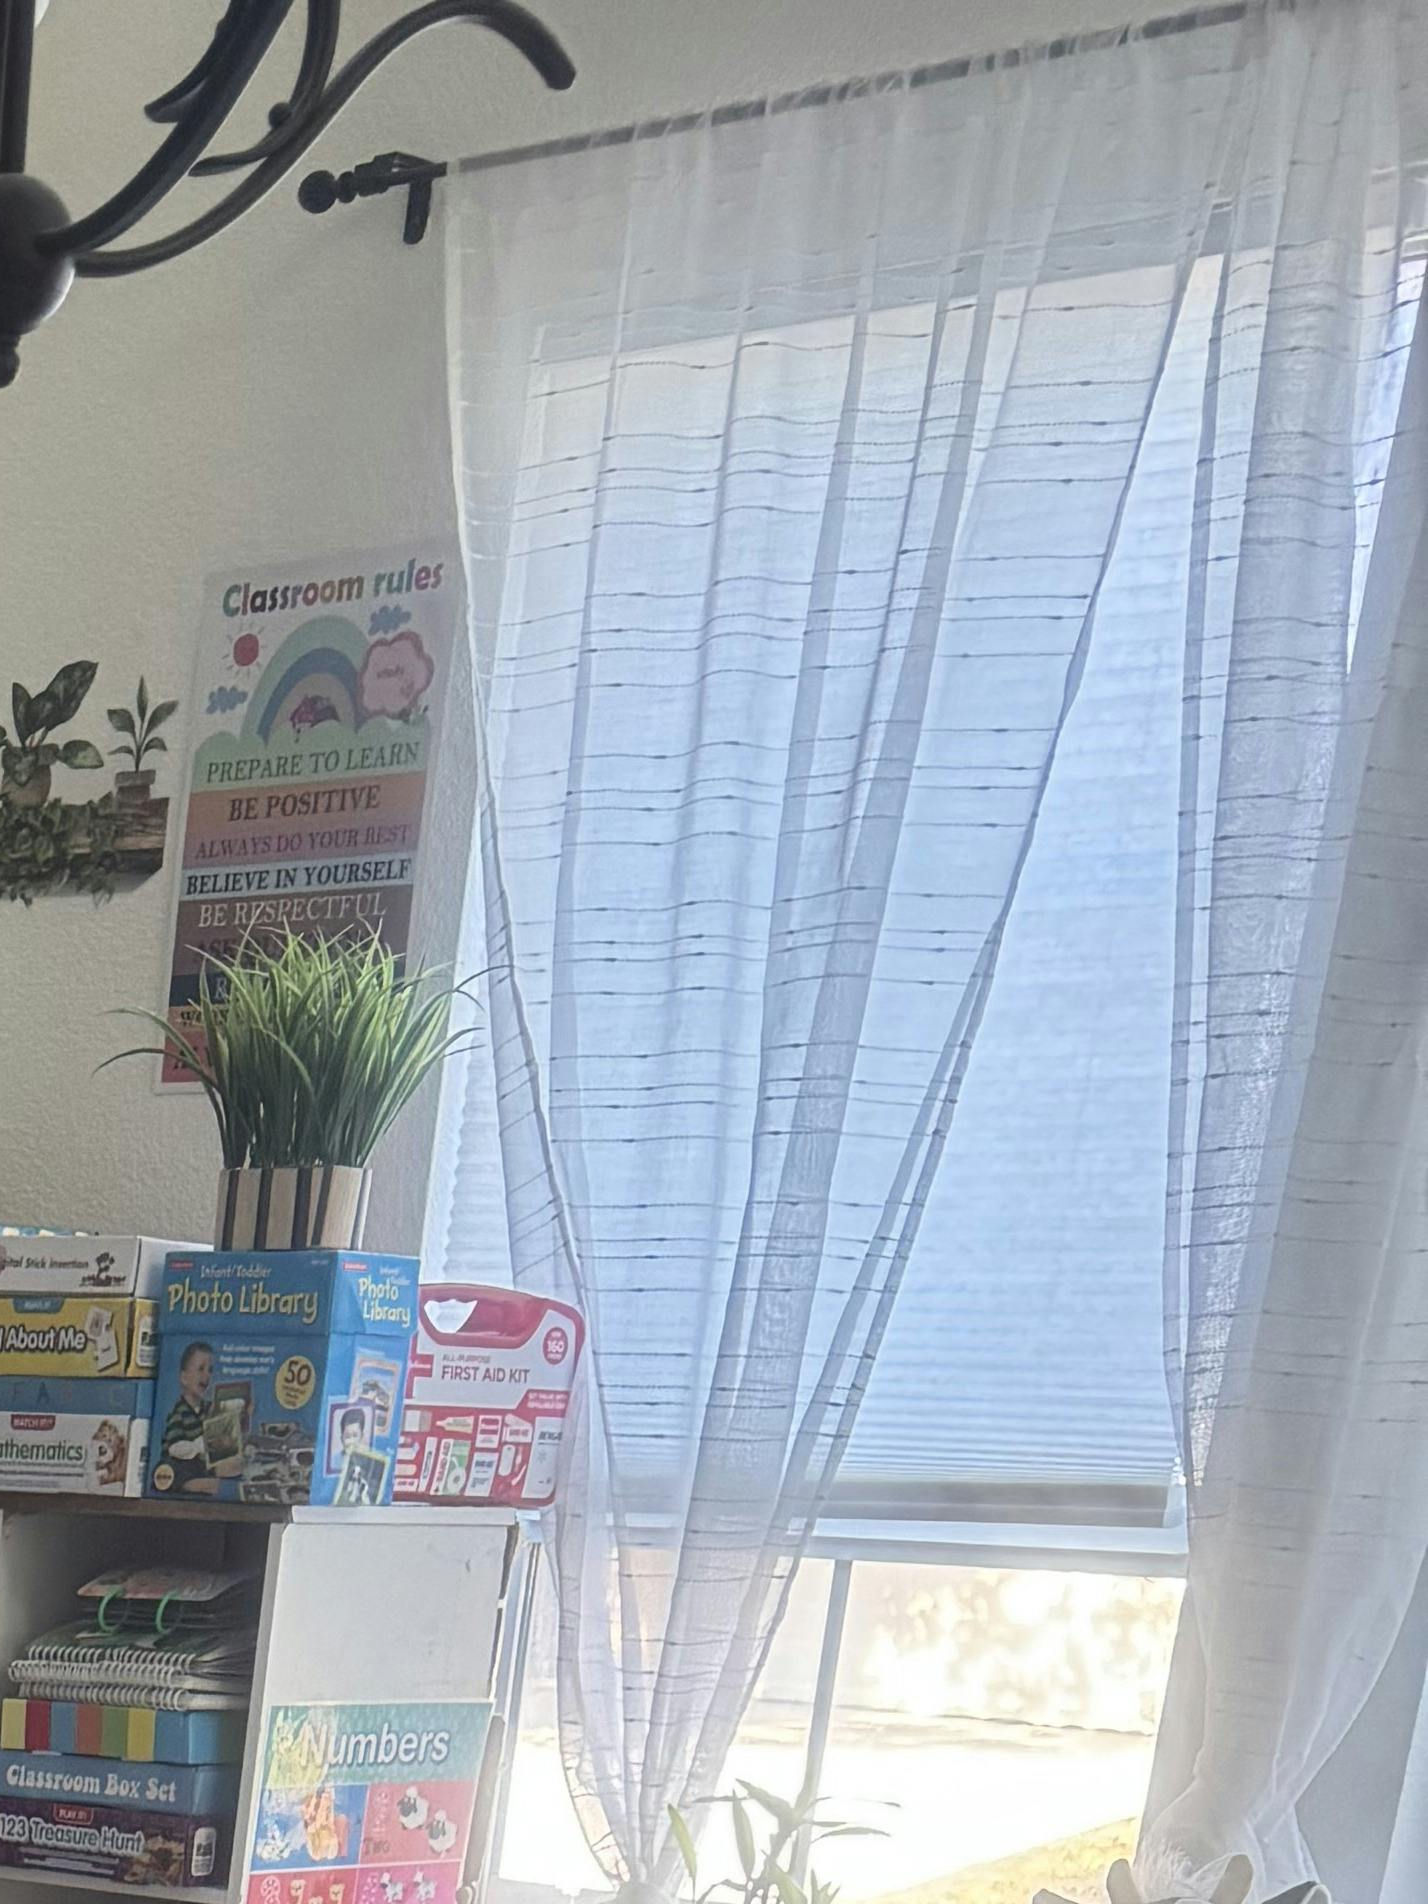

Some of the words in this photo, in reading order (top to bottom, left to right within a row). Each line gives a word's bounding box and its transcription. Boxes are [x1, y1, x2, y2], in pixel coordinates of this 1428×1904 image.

[222, 574, 364, 618] Classroom
[373, 558, 443, 596] rules
[207, 757, 302, 782] PREPARE
[308, 752, 340, 772] TO
[344, 742, 419, 769] LEARN
[228, 798, 259, 820] BE
[264, 785, 381, 817] POSITIVE
[186, 868, 267, 895] BELIEVE
[271, 865, 296, 887] IN
[302, 859, 411, 885] YOURSELF
[167, 1284, 232, 1314] Photo
[239, 1288, 318, 1324] Library
[5, 1328, 57, 1349] About
[59, 1327, 86, 1349] Me
[546, 1338, 565, 1353] 160
[283, 1362, 311, 1386] 50
[441, 1365, 477, 1383] FIRST
[481, 1366, 506, 1383] AID
[510, 1368, 530, 1383] KIT
[299, 1720, 449, 1764] Numbers
[7, 1765, 100, 1794] Classroom
[105, 1773, 140, 1798] Box
[147, 1777, 176, 1802] Set
[31, 1817, 95, 1850] Treasure
[100, 1828, 144, 1854] Hunt
